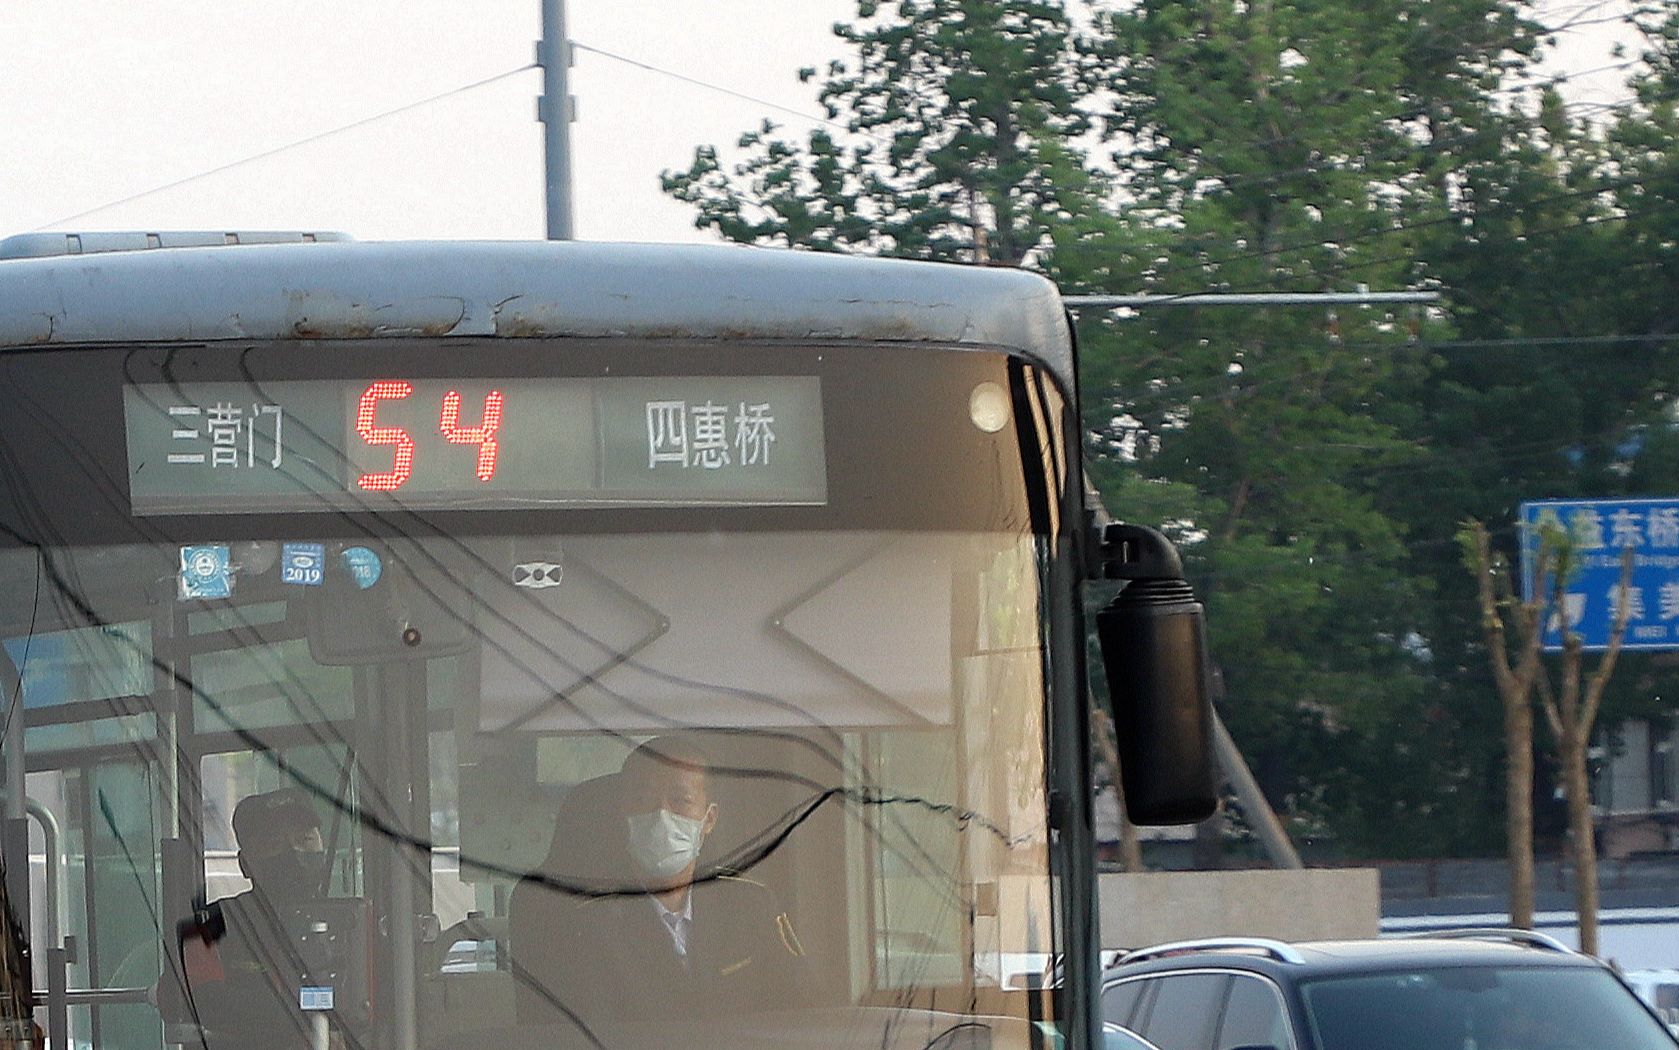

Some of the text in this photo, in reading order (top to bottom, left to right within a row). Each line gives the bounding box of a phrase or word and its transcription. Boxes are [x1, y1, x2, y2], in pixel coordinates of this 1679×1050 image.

[167, 381, 777, 492] 三营门 54 四惠桥
[286, 567, 321, 583] 2019
